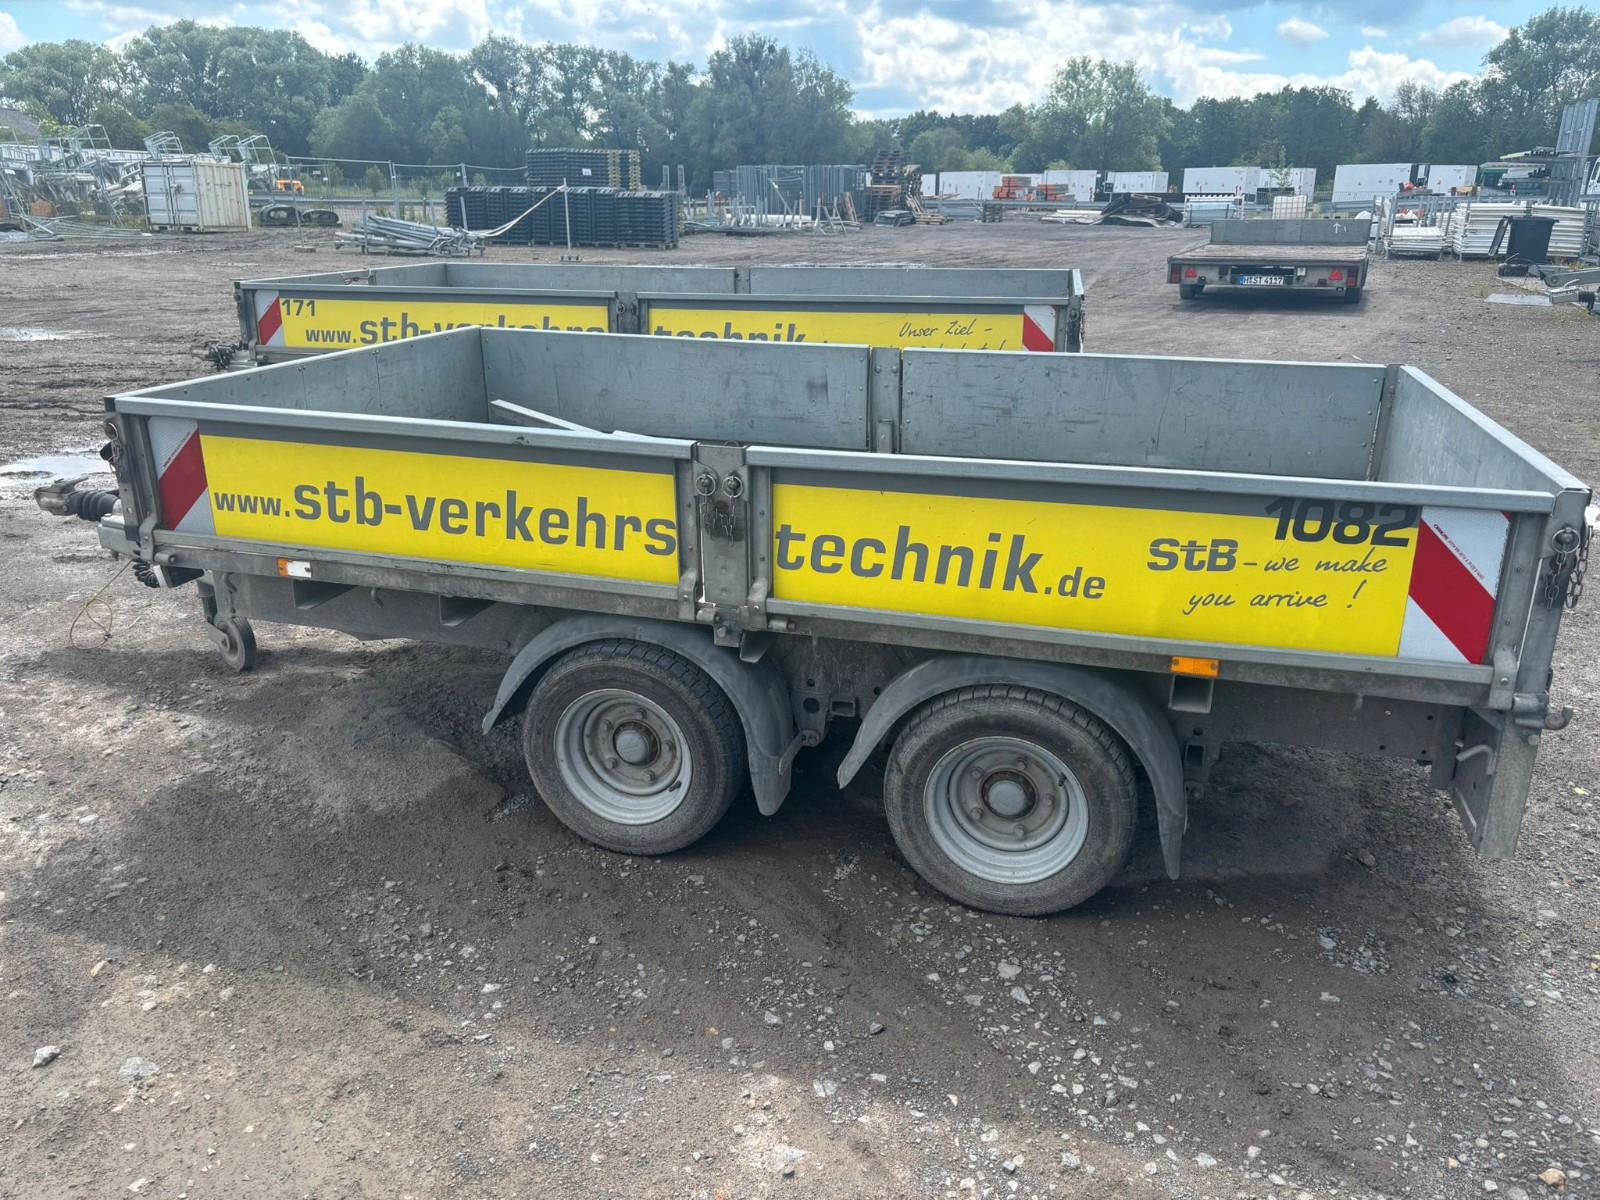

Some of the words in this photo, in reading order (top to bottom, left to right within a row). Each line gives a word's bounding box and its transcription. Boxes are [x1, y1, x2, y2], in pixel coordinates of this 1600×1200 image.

[282, 299, 316, 317] 171
[899, 321, 938, 337] Unser
[945, 318, 977, 336] Ziel
[1264, 496, 1419, 547] 1082
[214, 476, 679, 556] www.stb-verkehrs
[775, 525, 1106, 600] technik.de
[1148, 538, 1238, 572] StB
[1316, 547, 1387, 573] make
[1183, 592, 1235, 615] you
[1250, 590, 1328, 608] arrive
